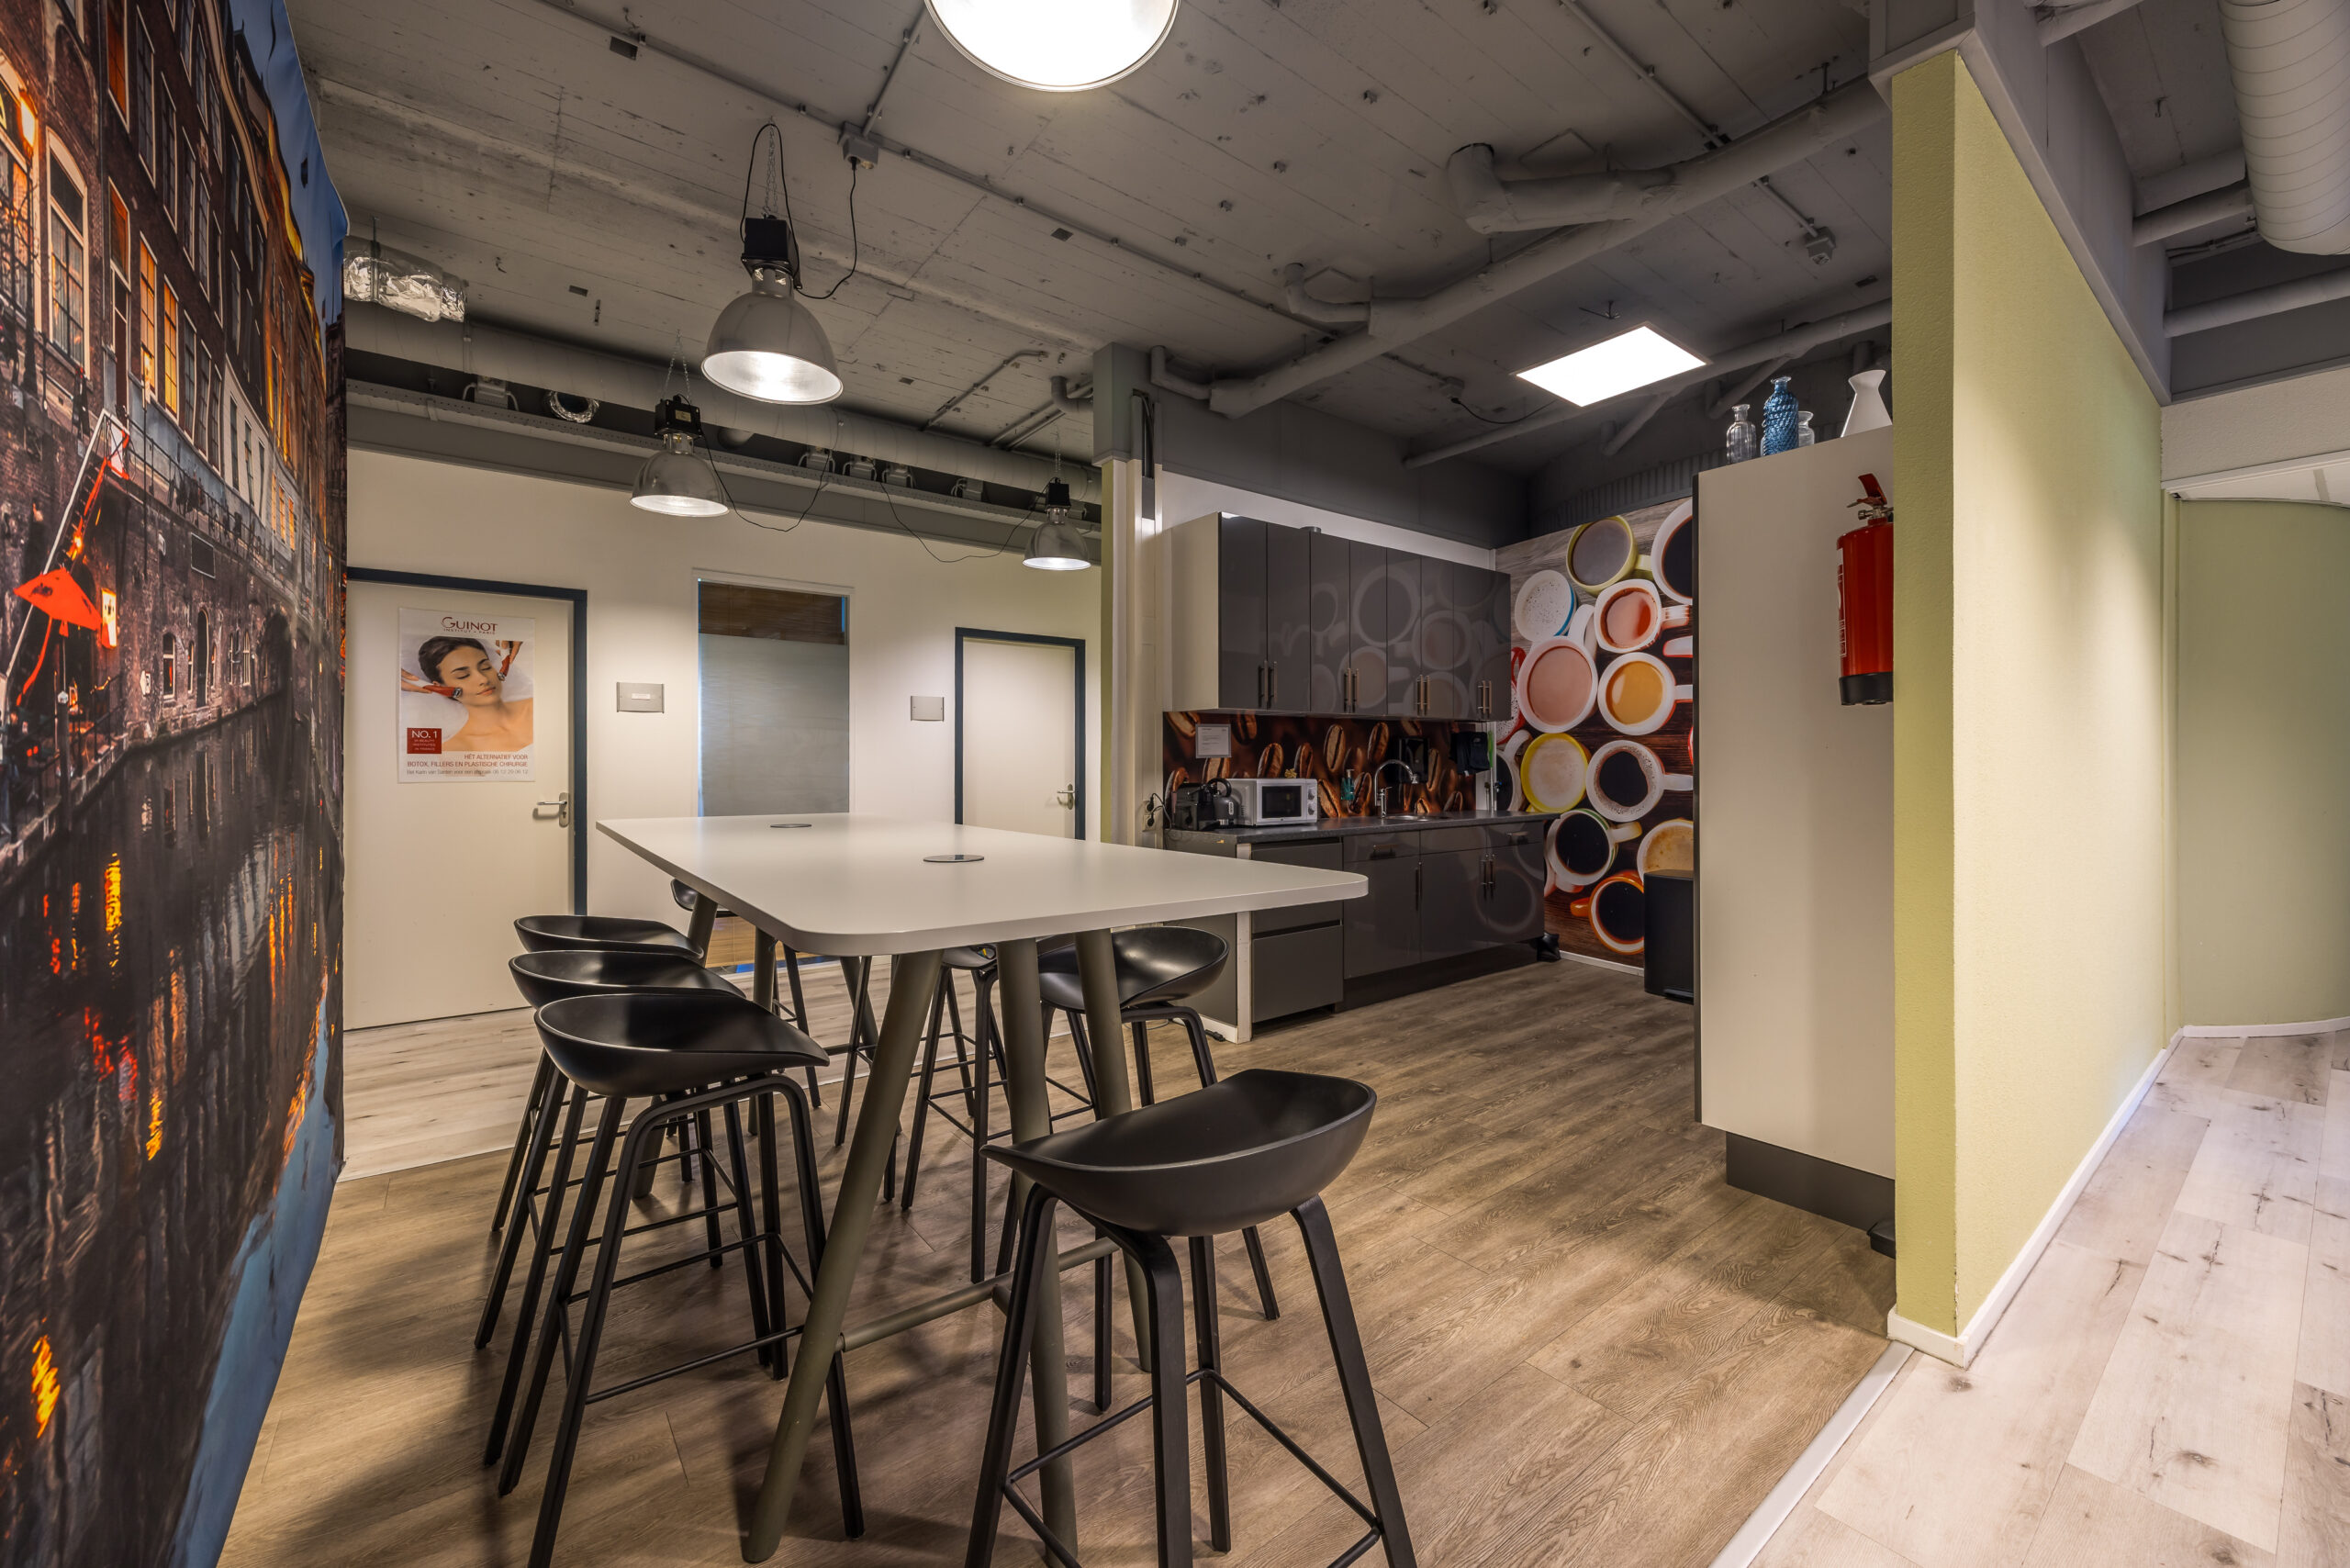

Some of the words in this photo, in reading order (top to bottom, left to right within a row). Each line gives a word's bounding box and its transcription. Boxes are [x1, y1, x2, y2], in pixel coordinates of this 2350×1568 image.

[441, 616, 498, 632] GUINOT
[411, 730, 431, 739] NO.
[433, 731, 438, 739] 1
